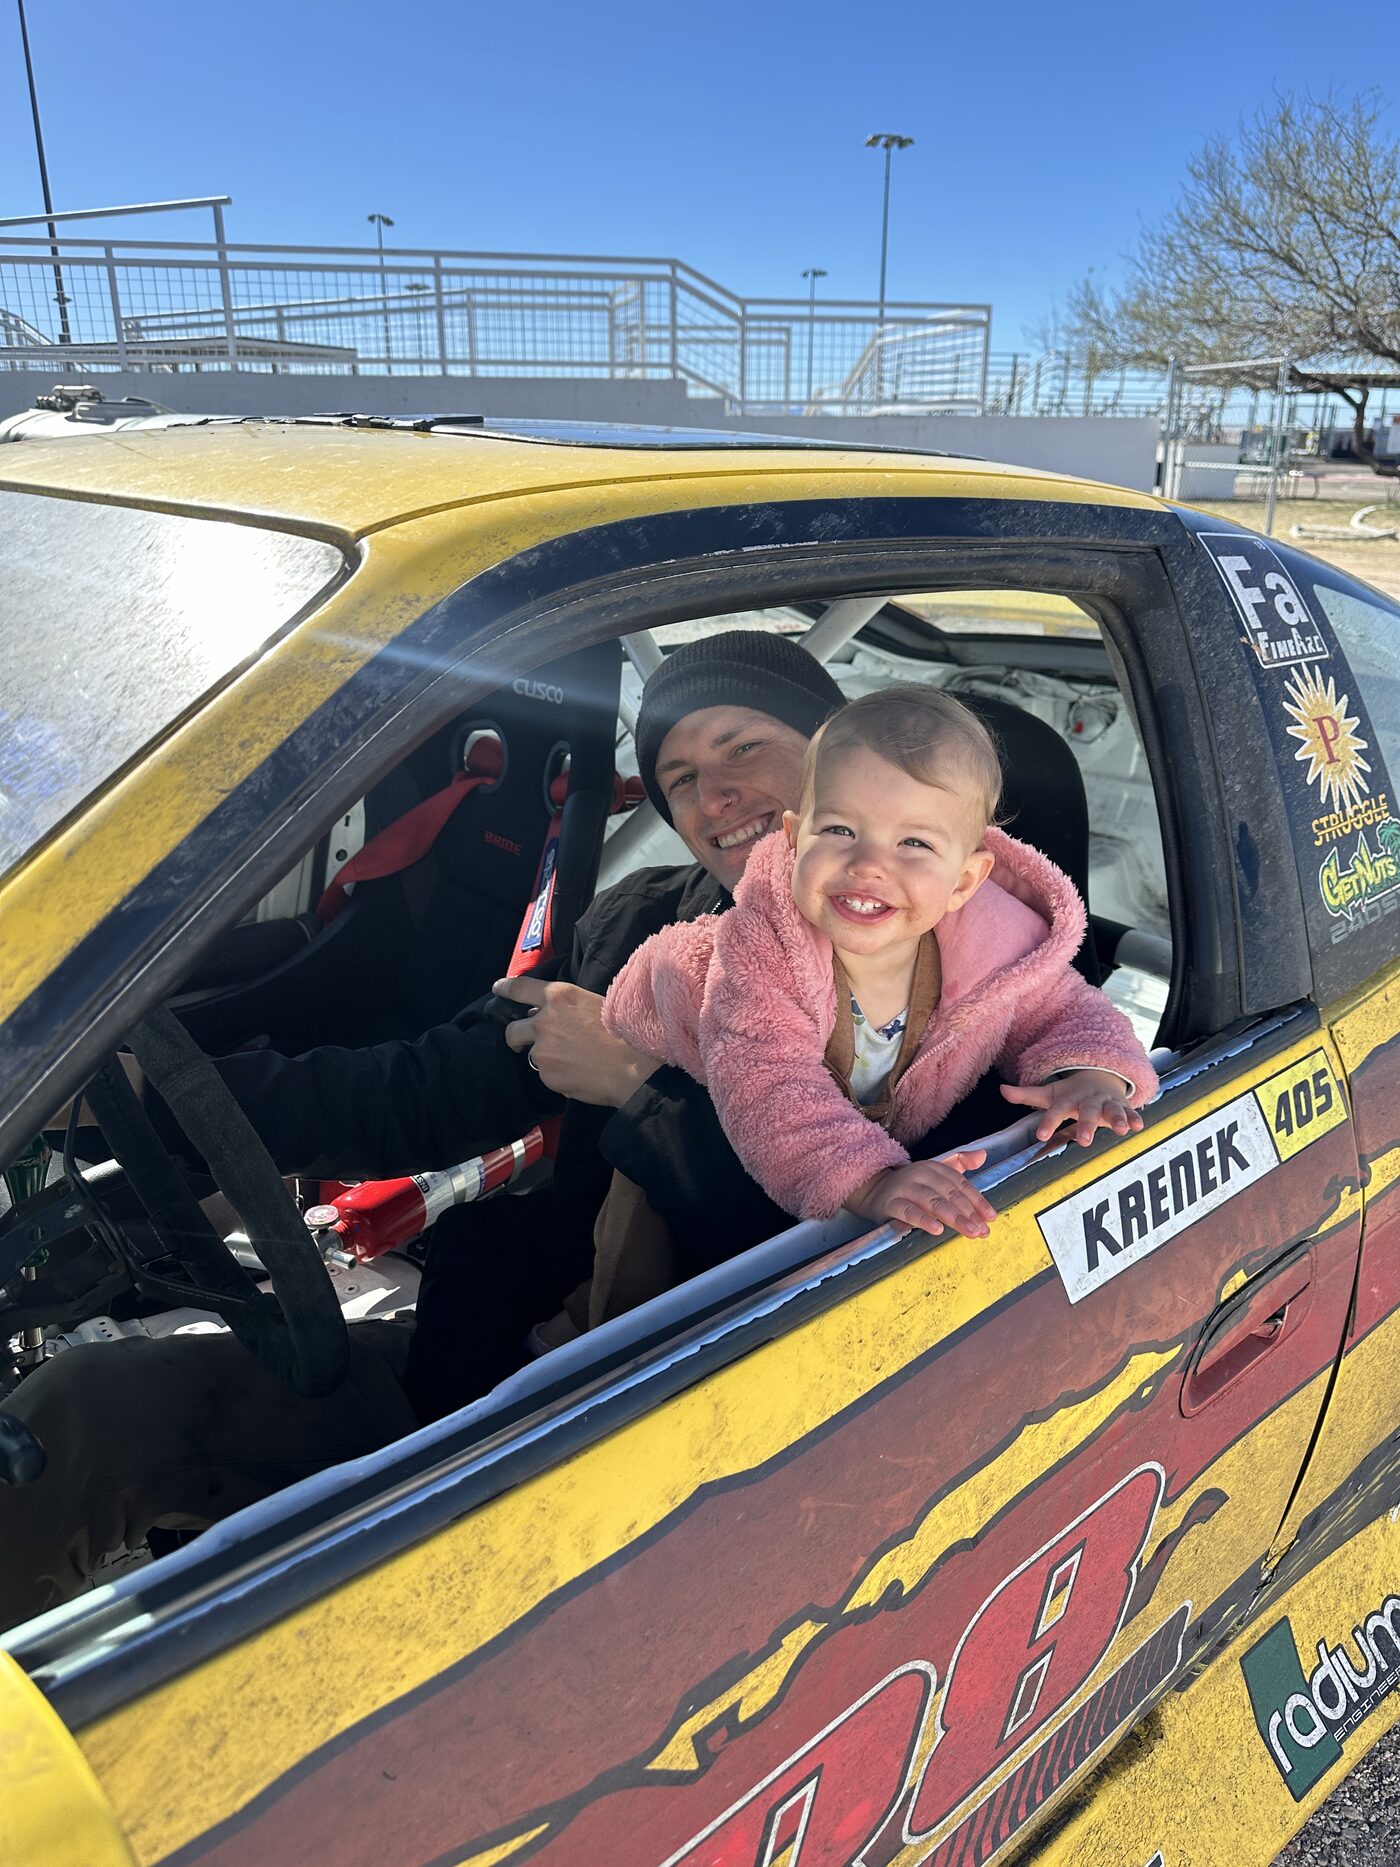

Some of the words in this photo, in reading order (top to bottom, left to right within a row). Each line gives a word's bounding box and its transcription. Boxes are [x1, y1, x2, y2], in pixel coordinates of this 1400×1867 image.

[1217, 556, 1309, 625] Fa
[512, 678, 563, 704] CUSCO
[1313, 715, 1341, 764] P
[484, 831, 522, 856] BRIDE
[1311, 793, 1390, 846] STRUGGLE
[1330, 890, 1400, 945] 240S
[1082, 1121, 1250, 1274] KRENEK
[1275, 1067, 1333, 1137] 405
[1268, 1597, 1400, 1774] radium
